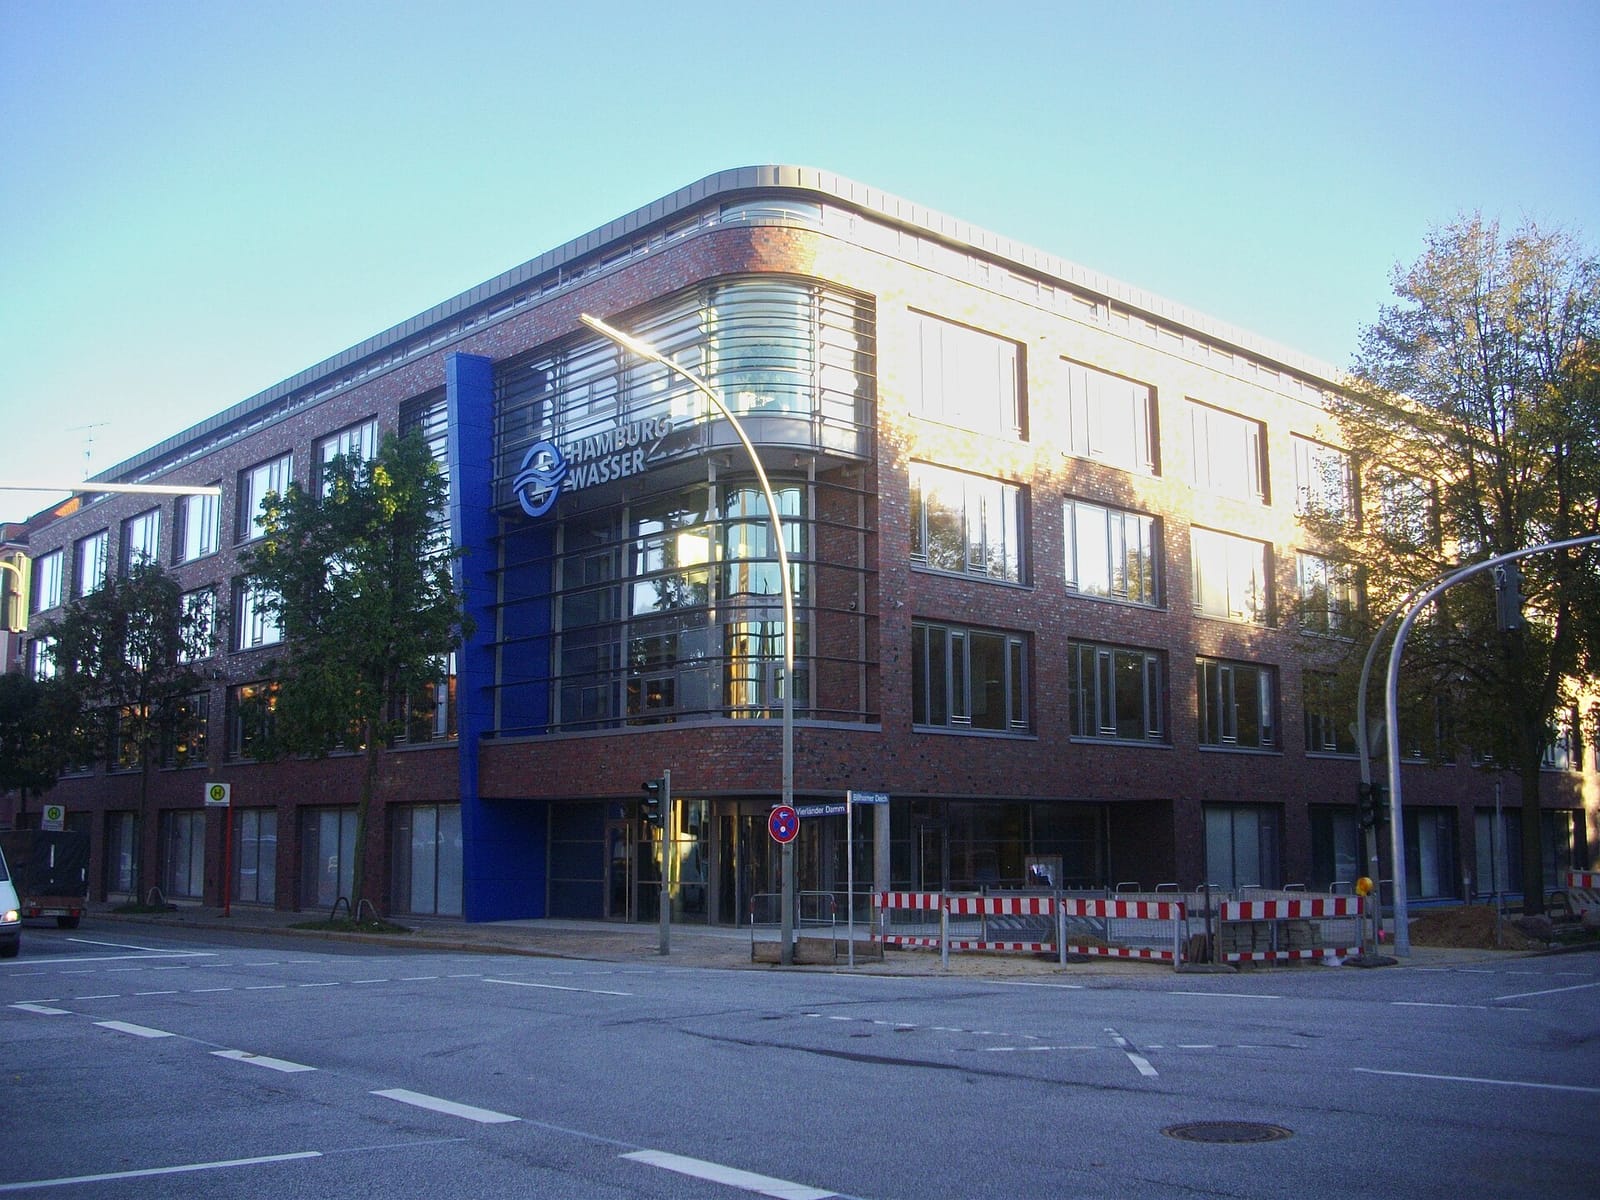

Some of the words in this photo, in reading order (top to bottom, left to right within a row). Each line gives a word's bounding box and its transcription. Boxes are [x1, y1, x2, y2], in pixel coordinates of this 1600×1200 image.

[569, 414, 672, 465] HAMBURG
[569, 448, 645, 491] WASSER
[214, 788, 222, 797] H
[825, 805, 845, 814] Damm
